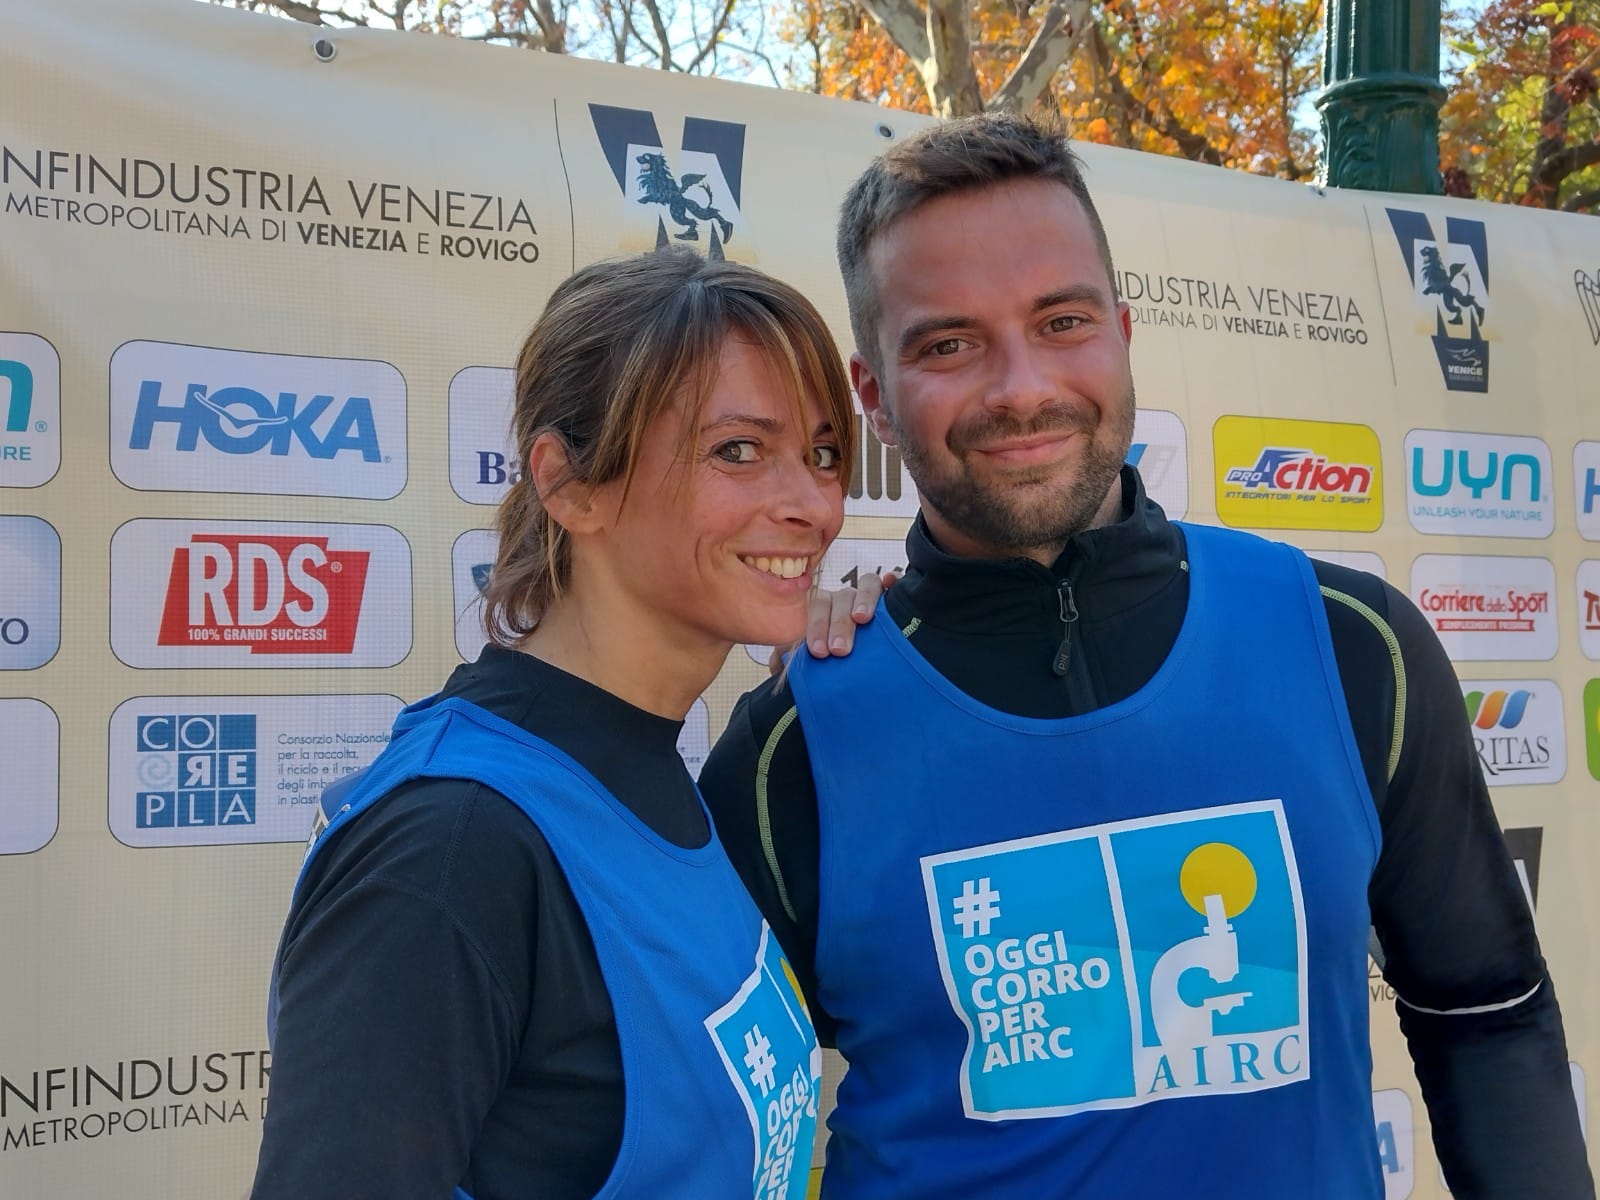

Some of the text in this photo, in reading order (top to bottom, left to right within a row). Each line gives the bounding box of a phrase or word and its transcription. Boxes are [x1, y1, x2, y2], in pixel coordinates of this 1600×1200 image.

[3, 146, 538, 236] NFINDUSTRIA VENEZIA
[5, 192, 539, 264] METROPOLITANA DI VENEZIA E ROVIGO
[1247, 285, 1365, 325] VENEZIA
[1203, 314, 1218, 331] DI
[1223, 316, 1289, 338] VENEZIA
[1295, 322, 1303, 340] E
[1308, 325, 1368, 345] ROVIGO
[1448, 364, 1484, 376] VENICE
[129, 380, 382, 463] HOKA
[0, 444, 32, 461] RE
[1296, 494, 1316, 502] PER
[1321, 495, 1335, 503] LO
[1340, 496, 1371, 504] SPORT
[1413, 506, 1543, 521] UNLEASH YOUR NATURE
[188, 541, 329, 627] RDS
[0, 617, 29, 645] O
[188, 628, 327, 641] 100% GRANDI SUCCESSI
[277, 731, 391, 745] Consorzio Nazionale
[277, 751, 296, 762] per
[301, 748, 310, 760] la
[278, 763, 284, 775] il
[287, 763, 319, 775] riciclo
[322, 766, 329, 775] e
[333, 762, 339, 774] il
[277, 778, 304, 793] degli
[278, 794, 287, 805] in
[964, 930, 1068, 976] OGGI
[971, 957, 1110, 1010] CORRO
[977, 1000, 1050, 1043] PER
[982, 1026, 1074, 1074] AIRC
[1147, 1034, 1301, 1095] AIRC
[3, 1099, 249, 1151] METROPOLITANA
